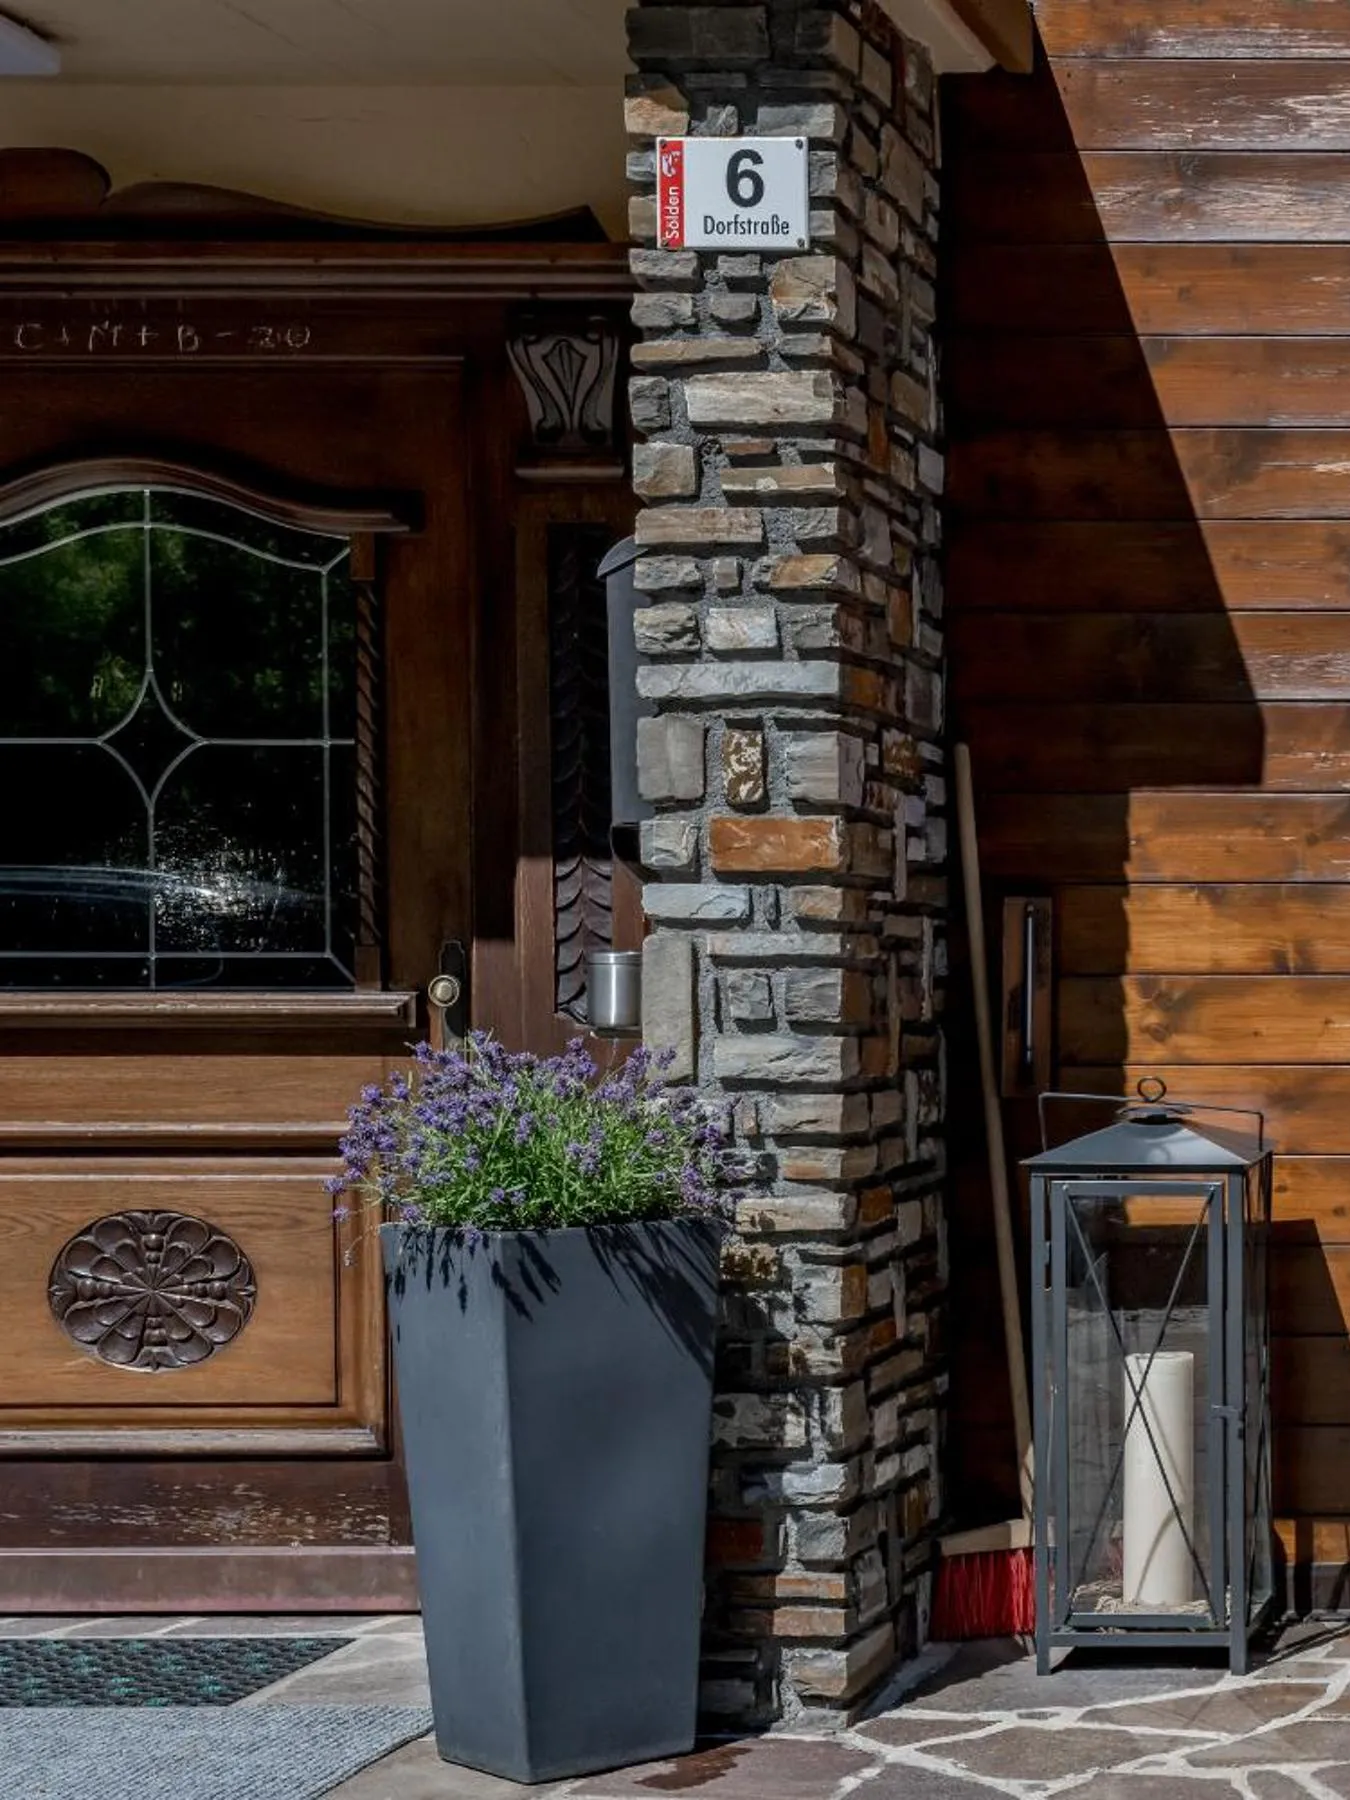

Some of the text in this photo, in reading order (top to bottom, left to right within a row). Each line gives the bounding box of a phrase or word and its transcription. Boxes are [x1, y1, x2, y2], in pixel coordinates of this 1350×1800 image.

[726, 148, 765, 208] 6
[664, 186, 680, 240] Sölden
[703, 213, 790, 236] Dorfstraße
